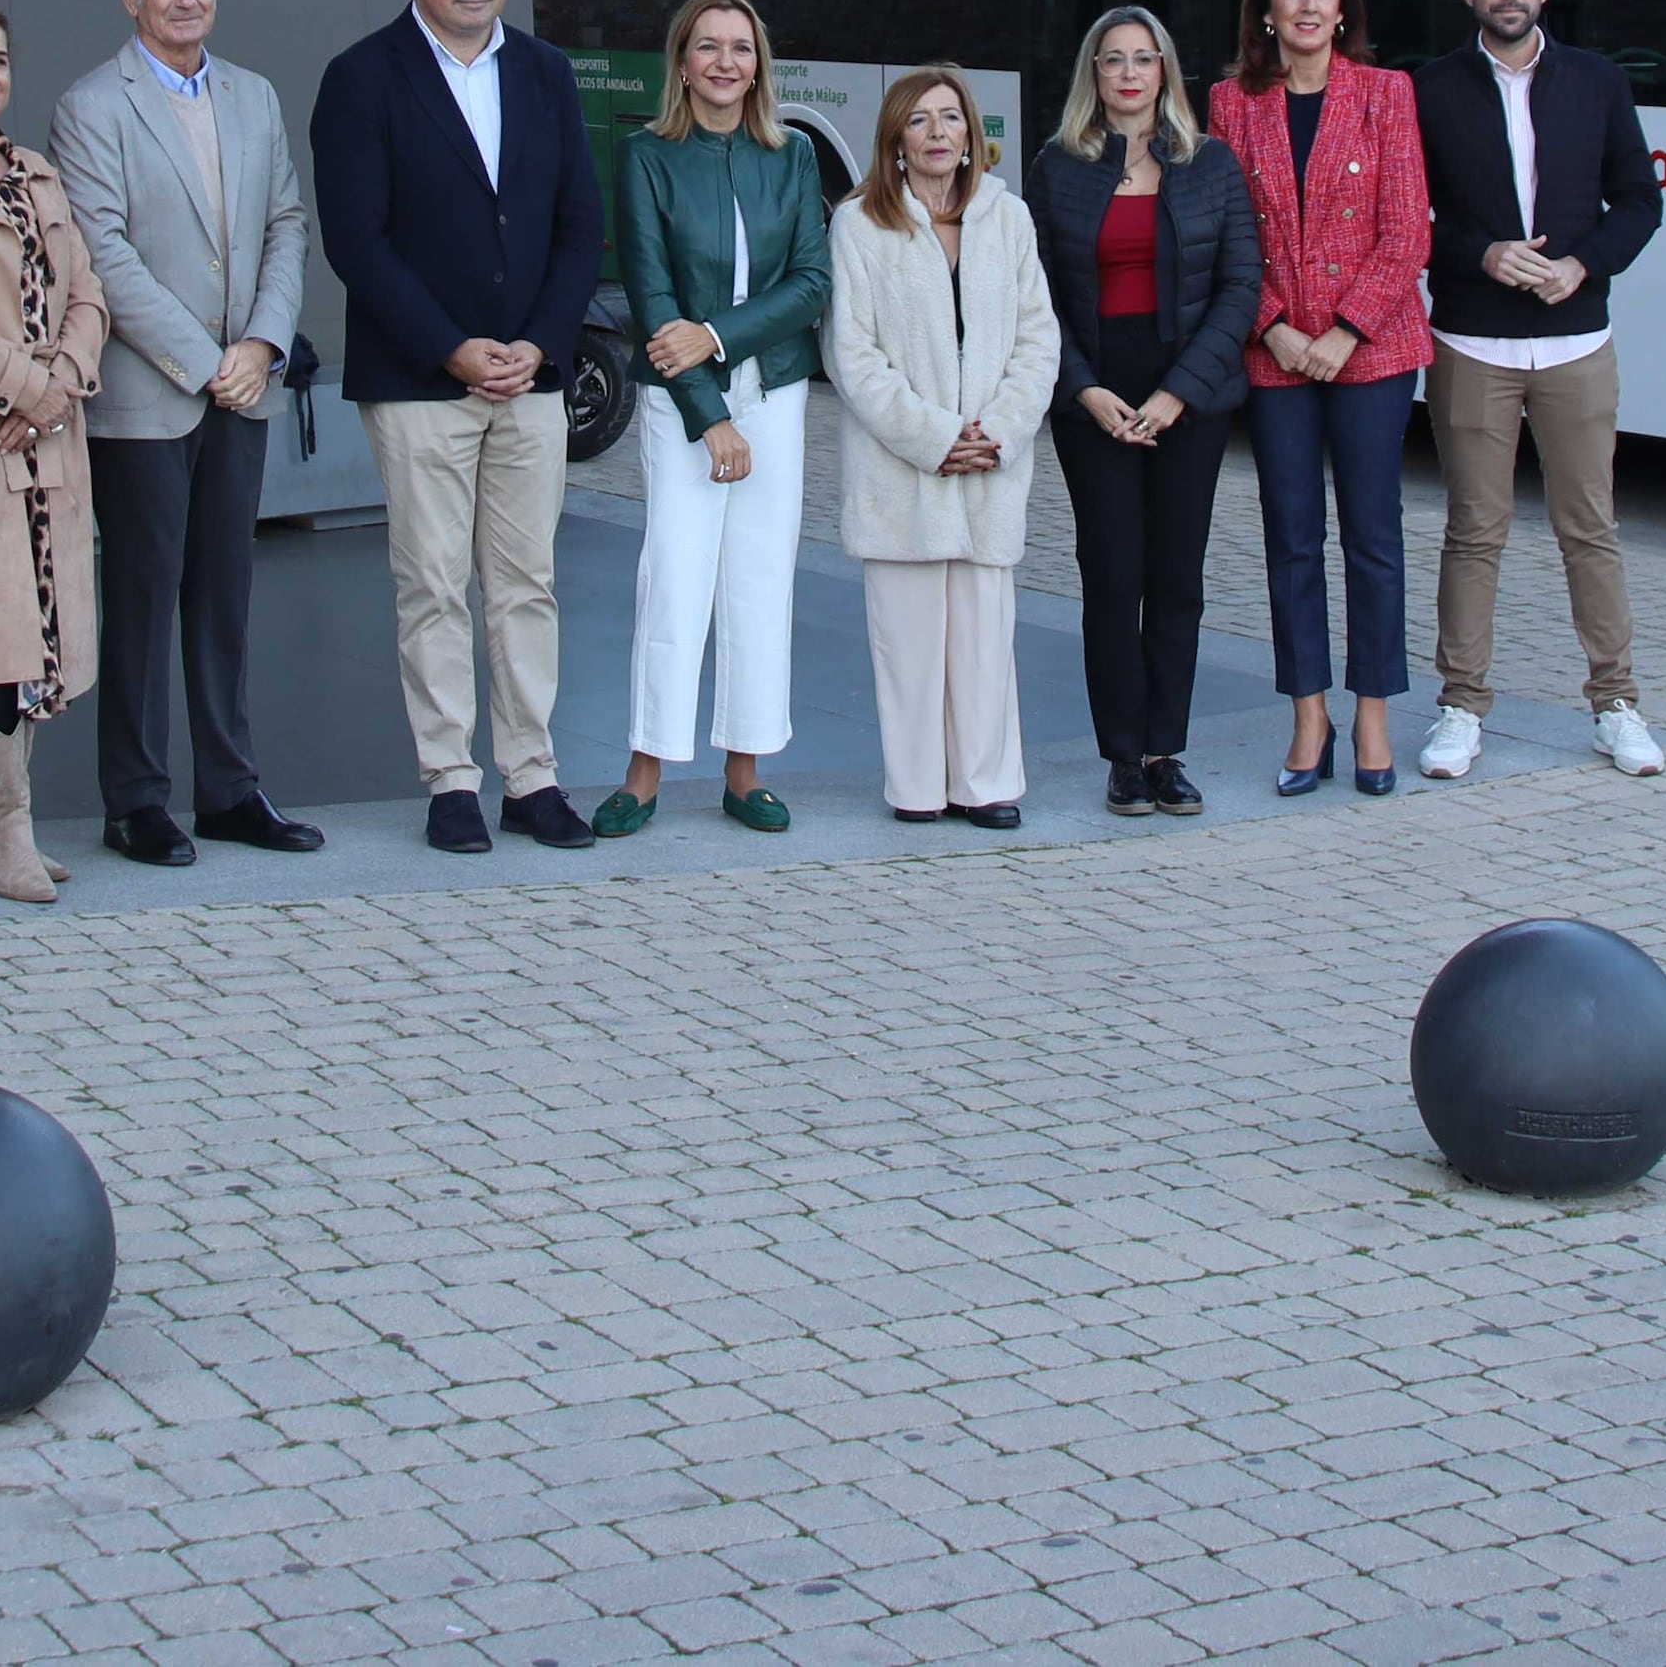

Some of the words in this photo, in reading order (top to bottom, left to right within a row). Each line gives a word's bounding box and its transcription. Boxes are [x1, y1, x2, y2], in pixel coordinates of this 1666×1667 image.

[781, 84, 801, 101] Área
[802, 87, 814, 102] de
[815, 86, 848, 107] Málaga
